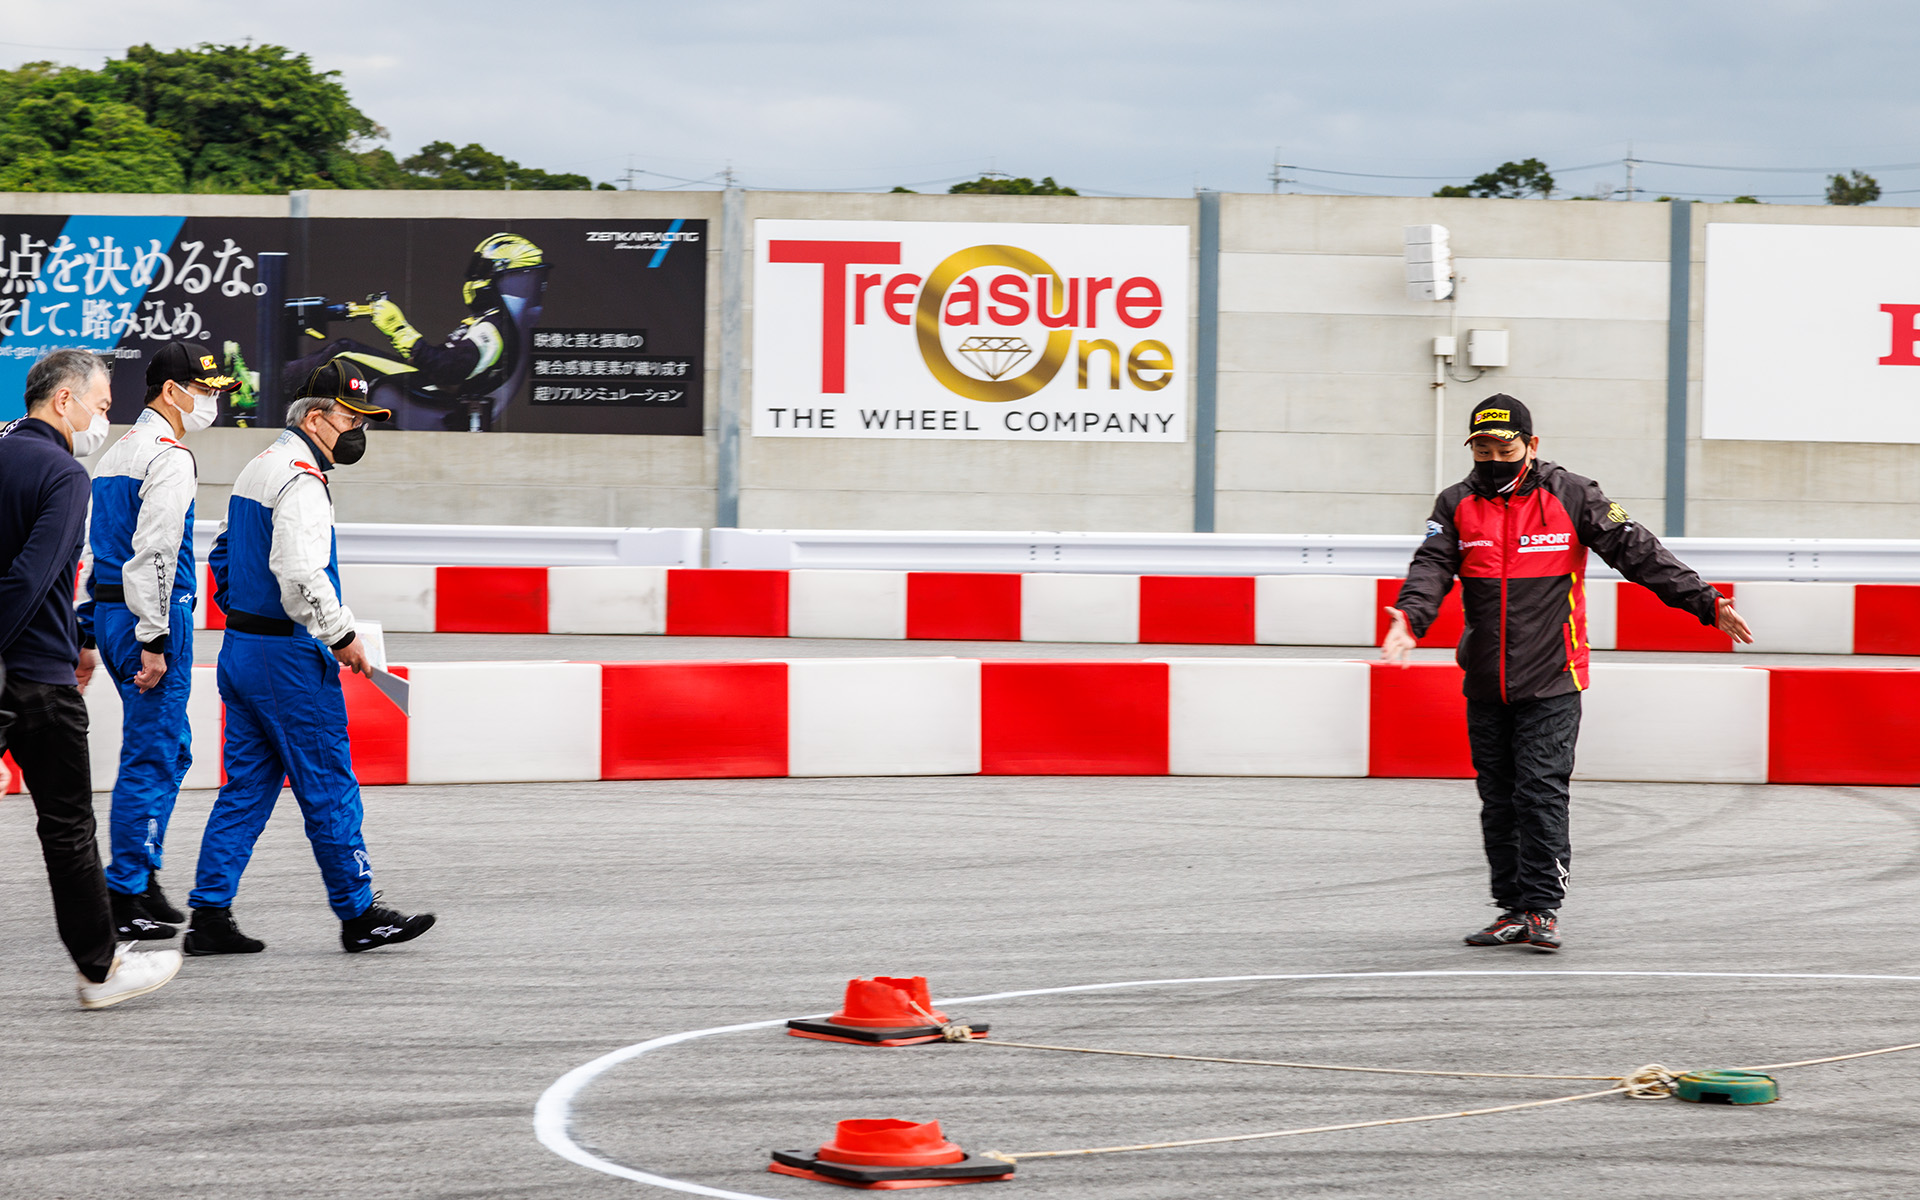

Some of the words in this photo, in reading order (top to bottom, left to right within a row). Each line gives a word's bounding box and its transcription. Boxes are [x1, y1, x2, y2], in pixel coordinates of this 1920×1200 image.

[0, 233, 267, 297] 点を決めるな。
[768, 239, 1163, 394] Treasure
[916, 244, 1175, 403] One
[533, 333, 644, 348] 映像と音と振動の
[534, 360, 691, 377] 複合感覚要素が織り成す
[533, 386, 684, 401] 超リアルシミュレーション
[768, 408, 836, 429] THE
[860, 409, 980, 431] WHEEL
[1004, 411, 1176, 434] COMPANY
[1482, 411, 1508, 420] SPORT
[1520, 535, 1530, 546] D
[1531, 533, 1571, 545] SPORT
